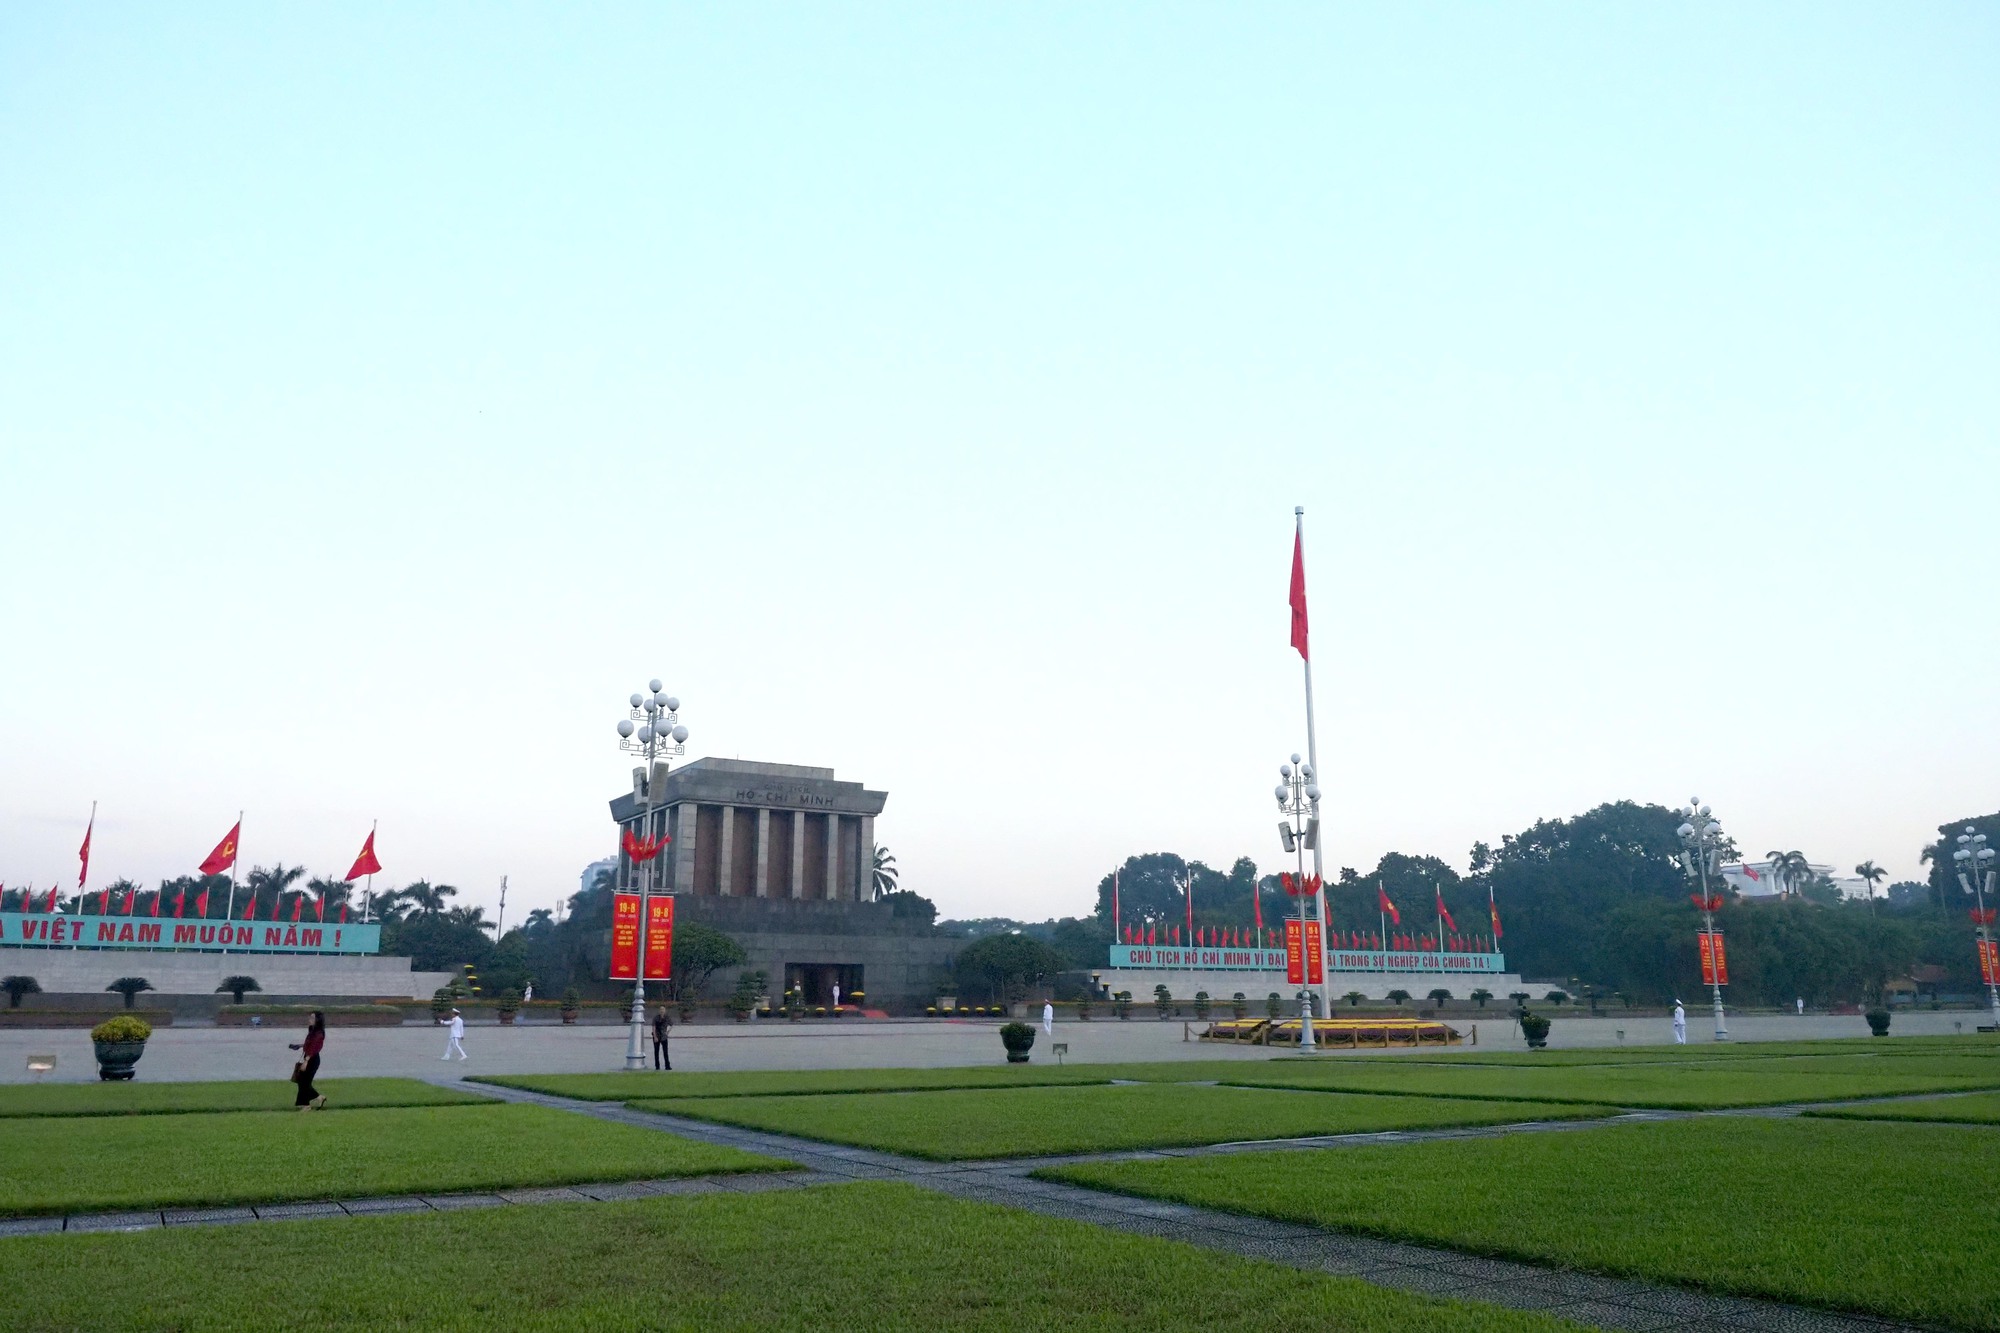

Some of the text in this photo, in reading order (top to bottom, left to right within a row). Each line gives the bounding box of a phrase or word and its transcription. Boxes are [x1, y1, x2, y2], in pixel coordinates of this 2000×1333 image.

[800, 795, 834, 806] MINH
[22, 917, 85, 944] VIỆT
[98, 922, 162, 943] NAM
[174, 922, 254, 945] MUÔN
[265, 924, 322, 947] NĂM
[1130, 947, 1152, 964] CHỦ
[1156, 950, 1180, 967] TỊCH
[1202, 949, 1219, 965] CHÍ
[1224, 952, 1250, 966] MINH
[1268, 953, 1285, 968] ĐẠI
[1340, 954, 1370, 967] TRONG
[1373, 953, 1385, 970] SỰ
[1388, 954, 1420, 970] NGHIỆP
[1423, 952, 1440, 967] CỦA
[1443, 954, 1471, 969] CHÚNG
[1473, 956, 1484, 969] TA
